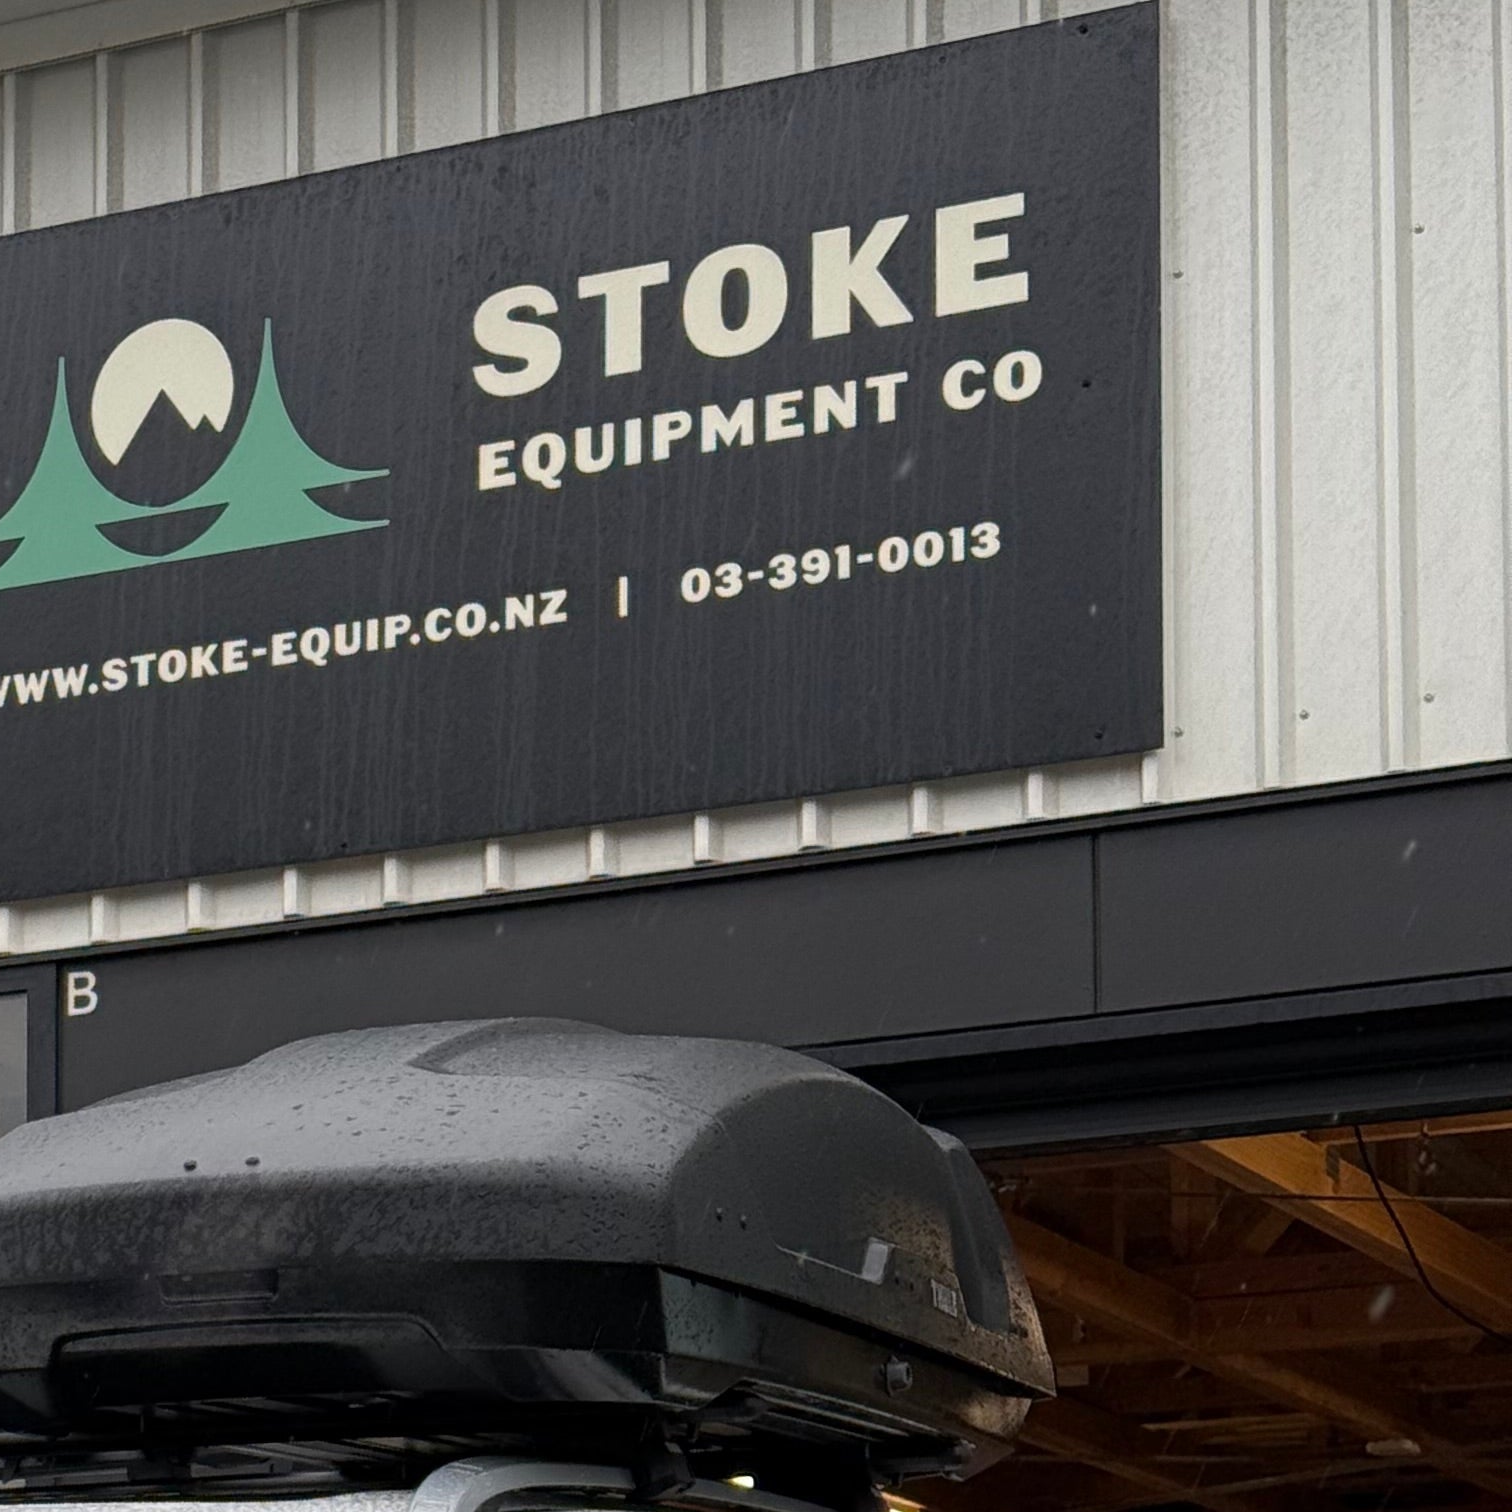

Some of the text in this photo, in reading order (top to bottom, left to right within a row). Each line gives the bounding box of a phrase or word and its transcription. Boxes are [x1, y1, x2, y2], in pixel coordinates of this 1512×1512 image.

[472, 192, 1030, 398] STOKE
[477, 349, 1044, 491] EQUIPMENT CO
[680, 521, 1002, 604] 03-391-0013
[68, 971, 98, 1016] B
